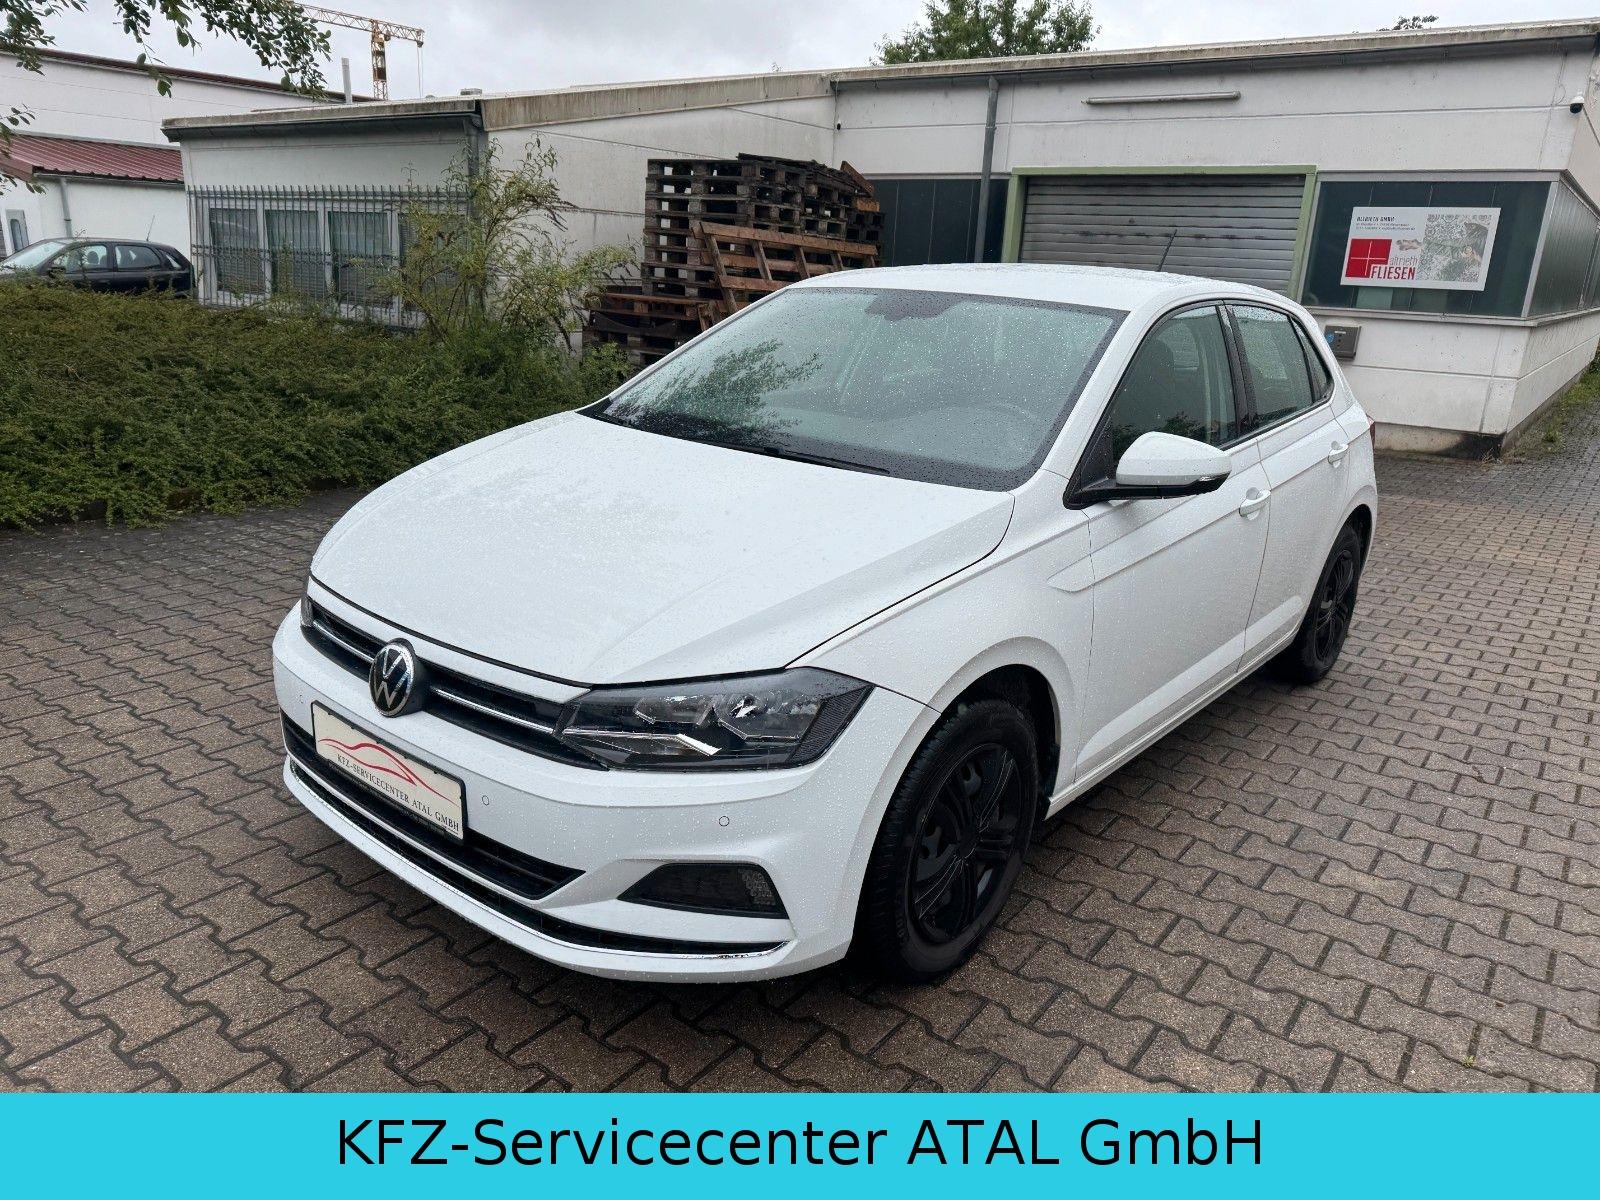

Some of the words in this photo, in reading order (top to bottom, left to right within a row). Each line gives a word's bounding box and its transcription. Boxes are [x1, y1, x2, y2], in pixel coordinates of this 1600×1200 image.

[1371, 266, 1416, 280] FLIESEN
[337, 754, 409, 803] KFZ-SERVICECENTER
[411, 799, 432, 817] ATAL
[435, 811, 459, 832] GMBH
